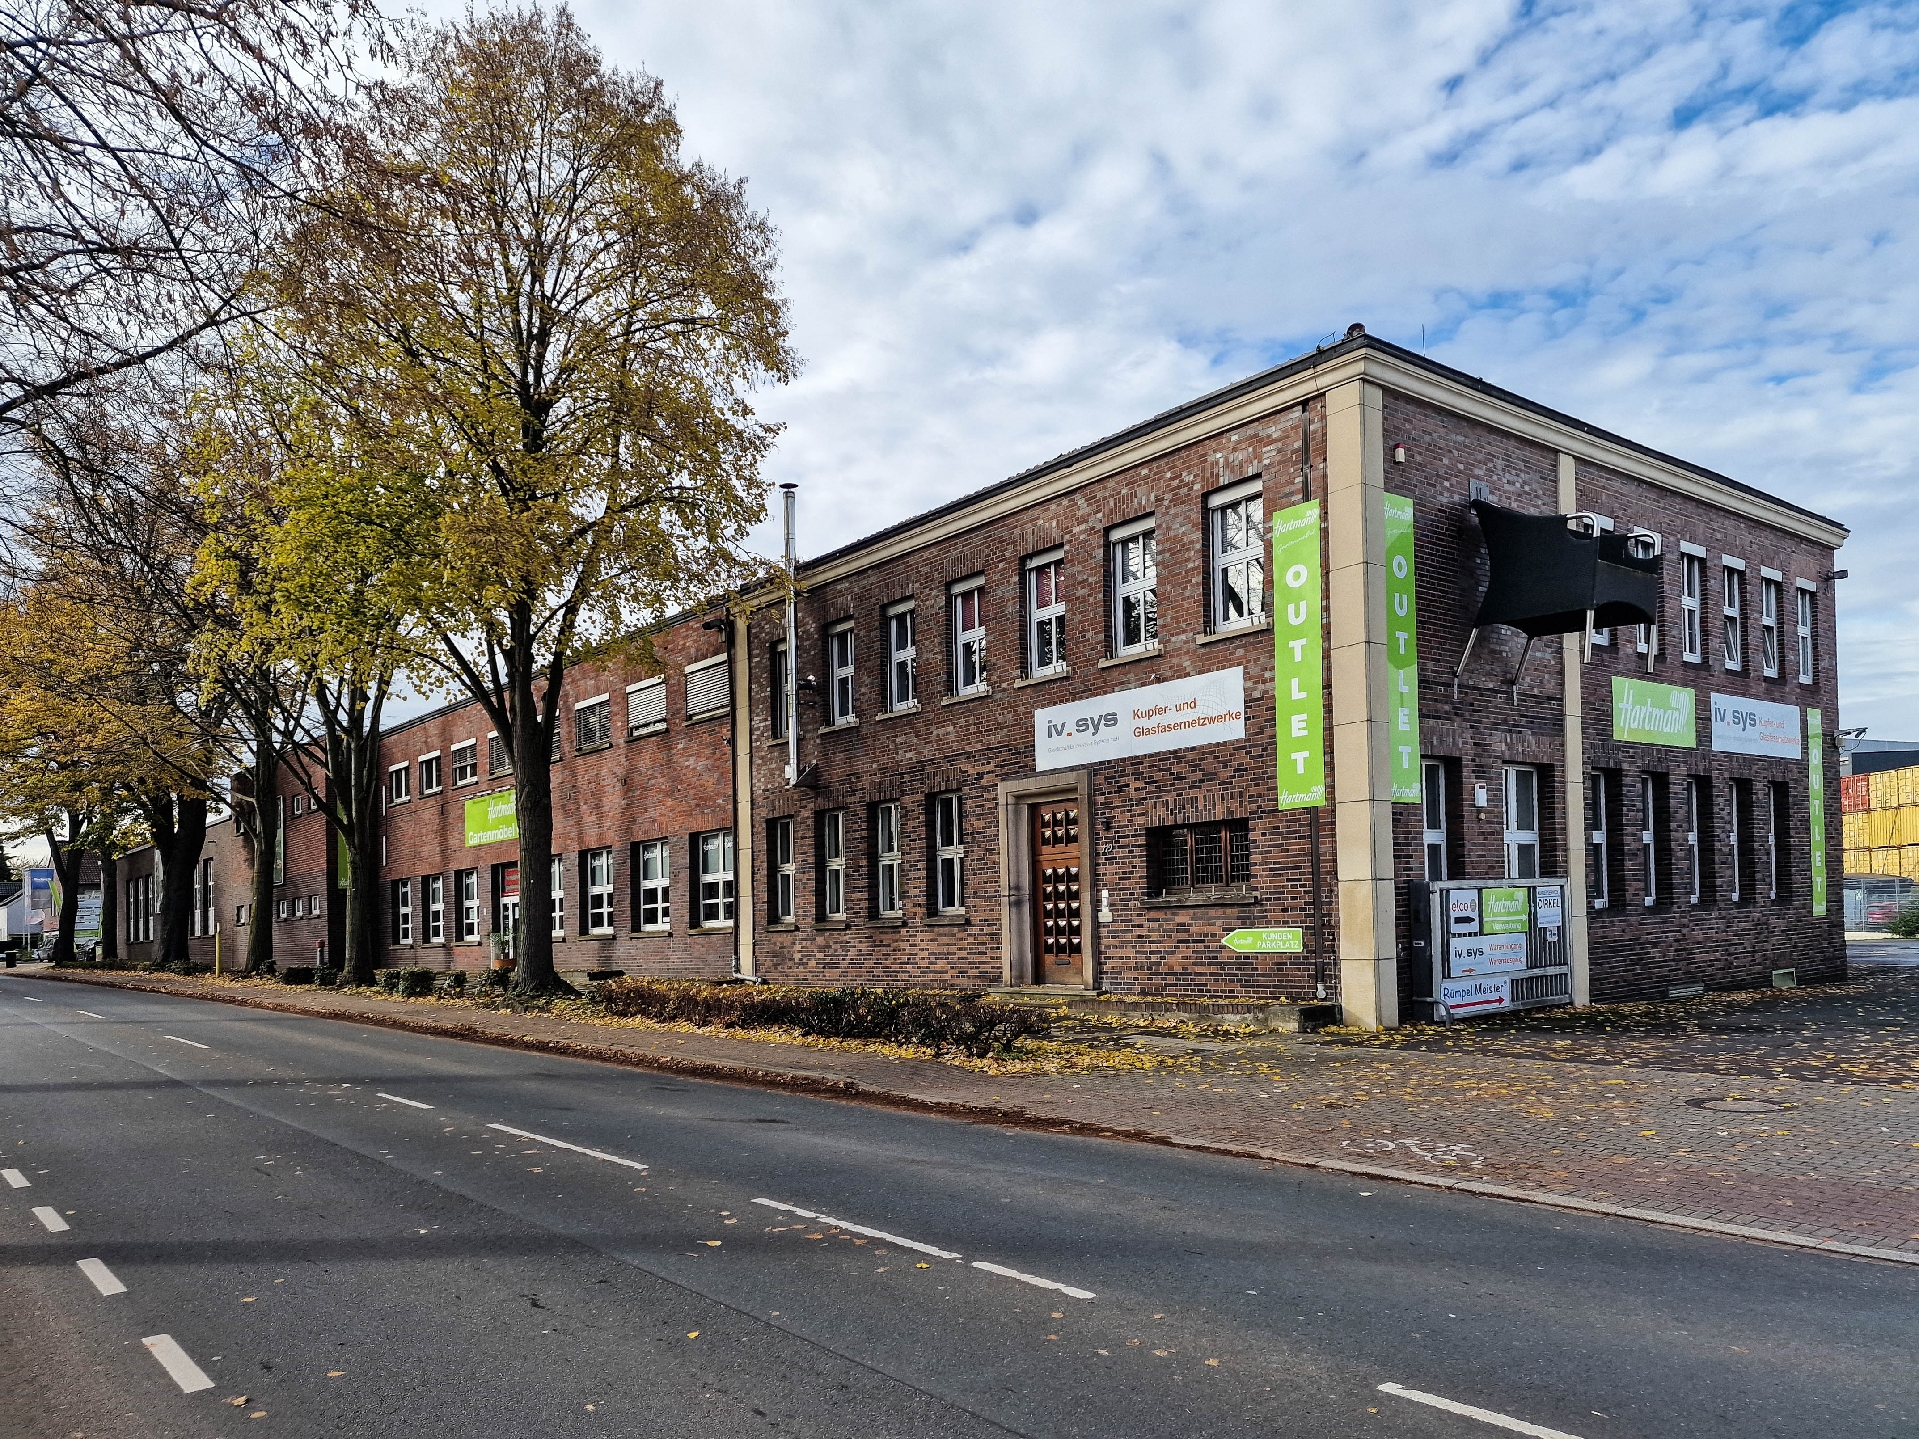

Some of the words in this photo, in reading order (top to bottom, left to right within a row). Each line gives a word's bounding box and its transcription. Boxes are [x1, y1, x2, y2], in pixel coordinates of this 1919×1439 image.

[1285, 564, 1309, 775] OUTLET
[1392, 555, 1412, 769] OUTLET
[1132, 705, 1172, 723] Kupfer-
[1175, 698, 1197, 713] und
[1714, 701, 1757, 732] iv.sys
[1047, 711, 1118, 738] iv.sys
[1133, 710, 1242, 738] Glasfasernetzwerke
[468, 823, 515, 844] Gartenmöbel
[1811, 749, 1822, 892] OUTLET
[1451, 899, 1469, 912] elco
[1257, 940, 1299, 949] PARKPLATZ
[1262, 932, 1293, 940] KUNDEN
[1454, 947, 1485, 959] iv.sys
